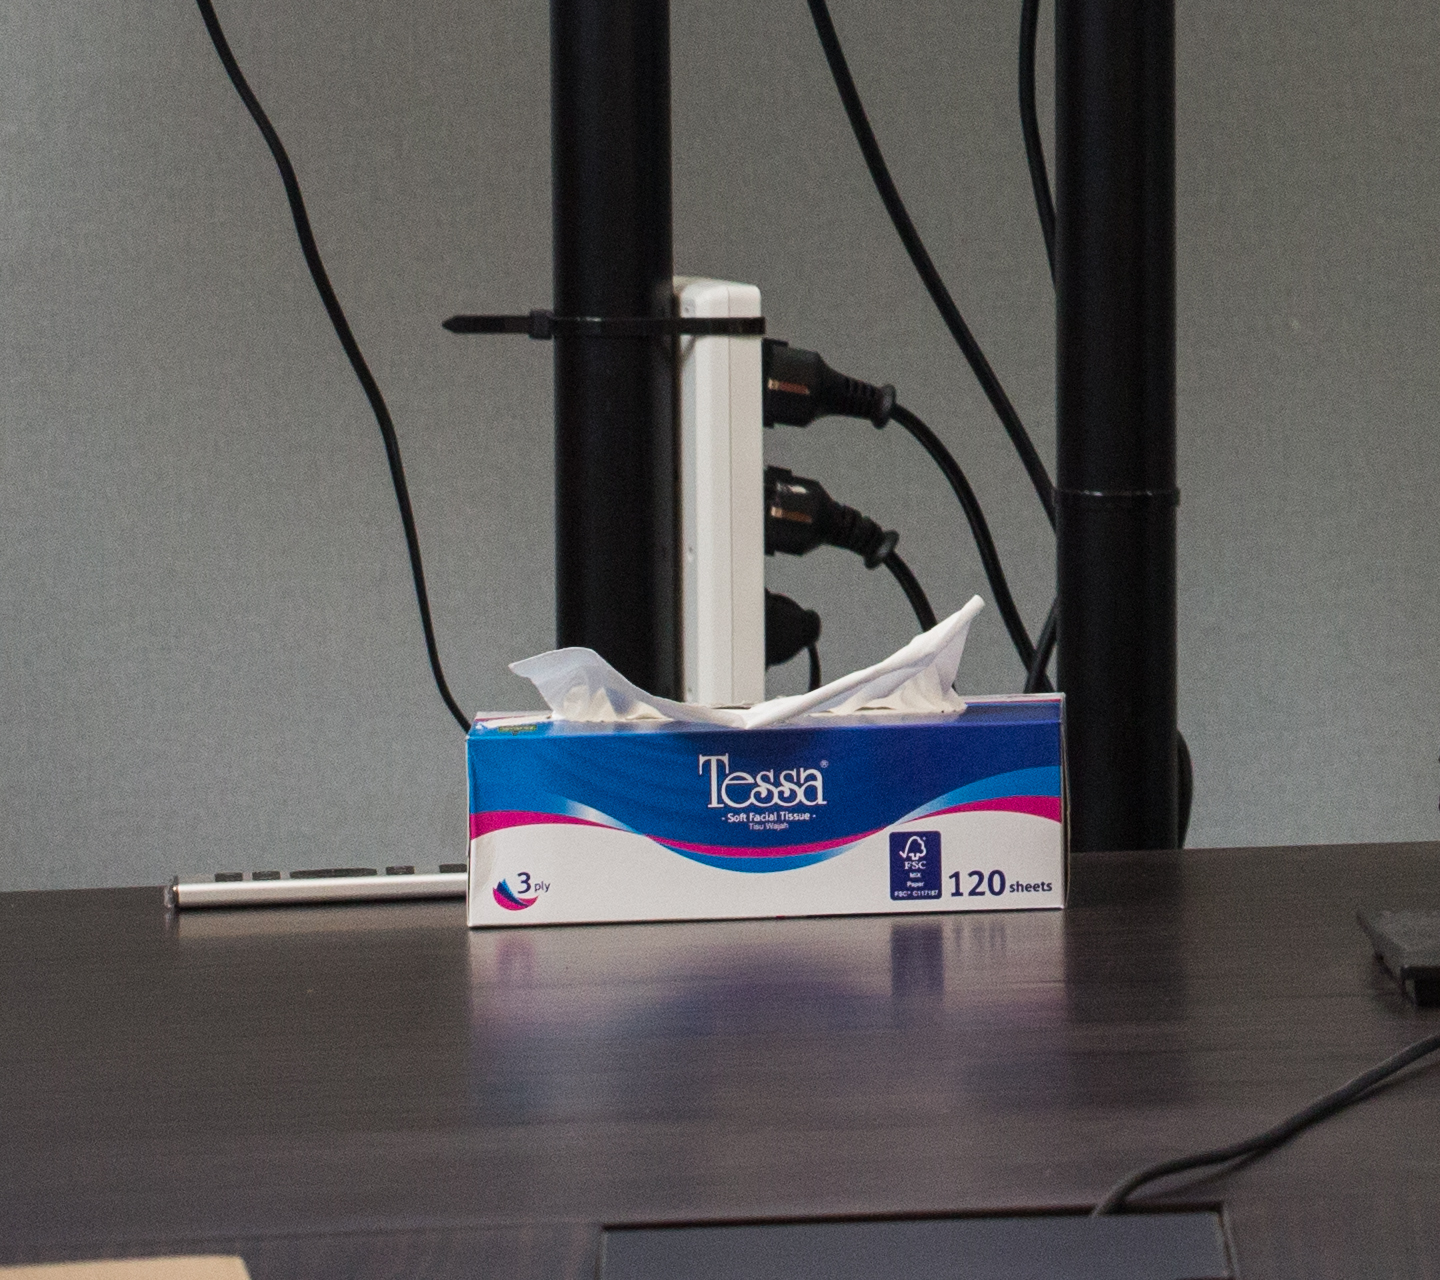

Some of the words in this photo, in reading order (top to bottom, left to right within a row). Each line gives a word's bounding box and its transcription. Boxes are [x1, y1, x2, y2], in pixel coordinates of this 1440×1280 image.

[698, 753, 828, 809] Tessa
[727, 812, 748, 823] Soft
[749, 811, 777, 823] Facial
[779, 810, 811, 821] Tissue
[748, 822, 765, 831] Tisu
[765, 821, 789, 831] Wajah
[904, 860, 927, 870] FSC
[517, 871, 532, 895] 3
[534, 880, 551, 893] ply
[906, 880, 925, 888] Paper
[948, 869, 1007, 898] 120
[1009, 880, 1053, 894] sheets
